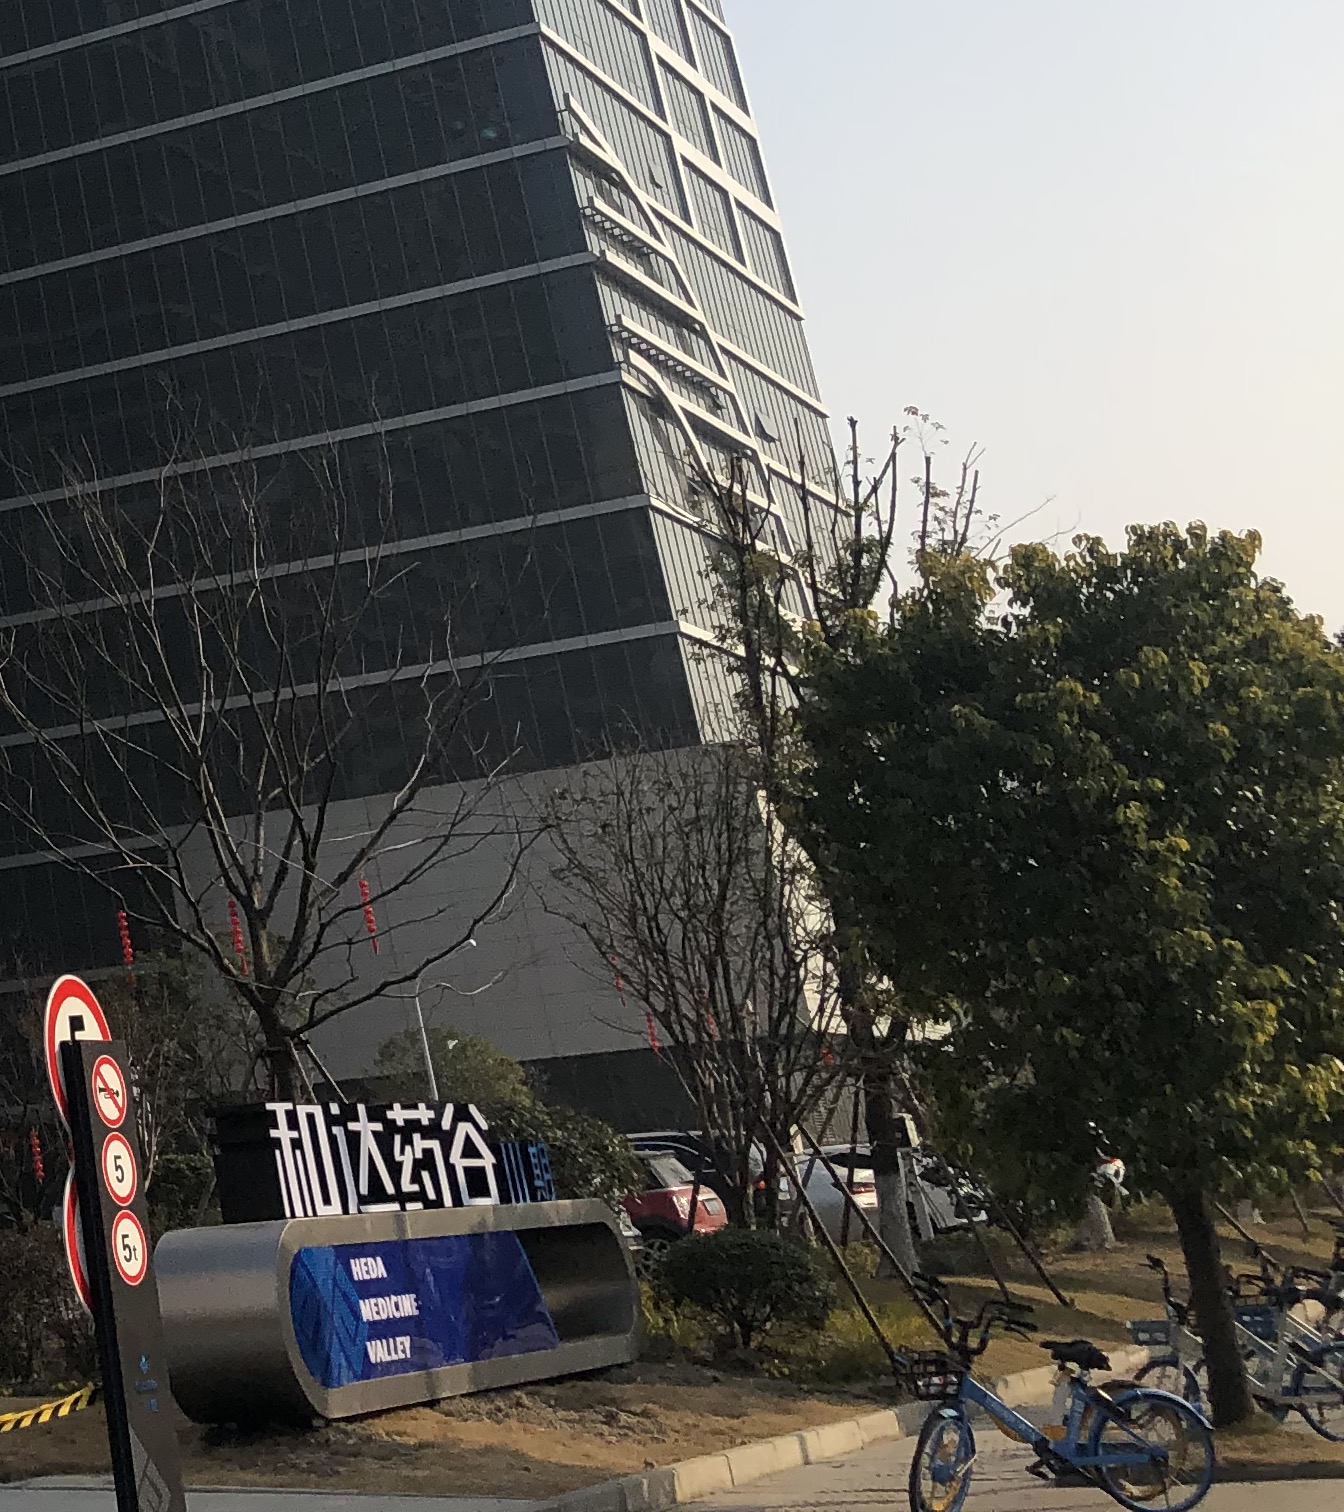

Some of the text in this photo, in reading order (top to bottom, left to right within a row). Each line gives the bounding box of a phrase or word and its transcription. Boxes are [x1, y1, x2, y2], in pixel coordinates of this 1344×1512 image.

[113, 1154, 125, 1184] 5
[265, 1102, 501, 1218] 和达药谷
[120, 1233, 139, 1263] 5t
[349, 1256, 388, 1281] HEDA
[358, 1293, 420, 1322] MEDICINE
[365, 1335, 412, 1364] VALLEY
